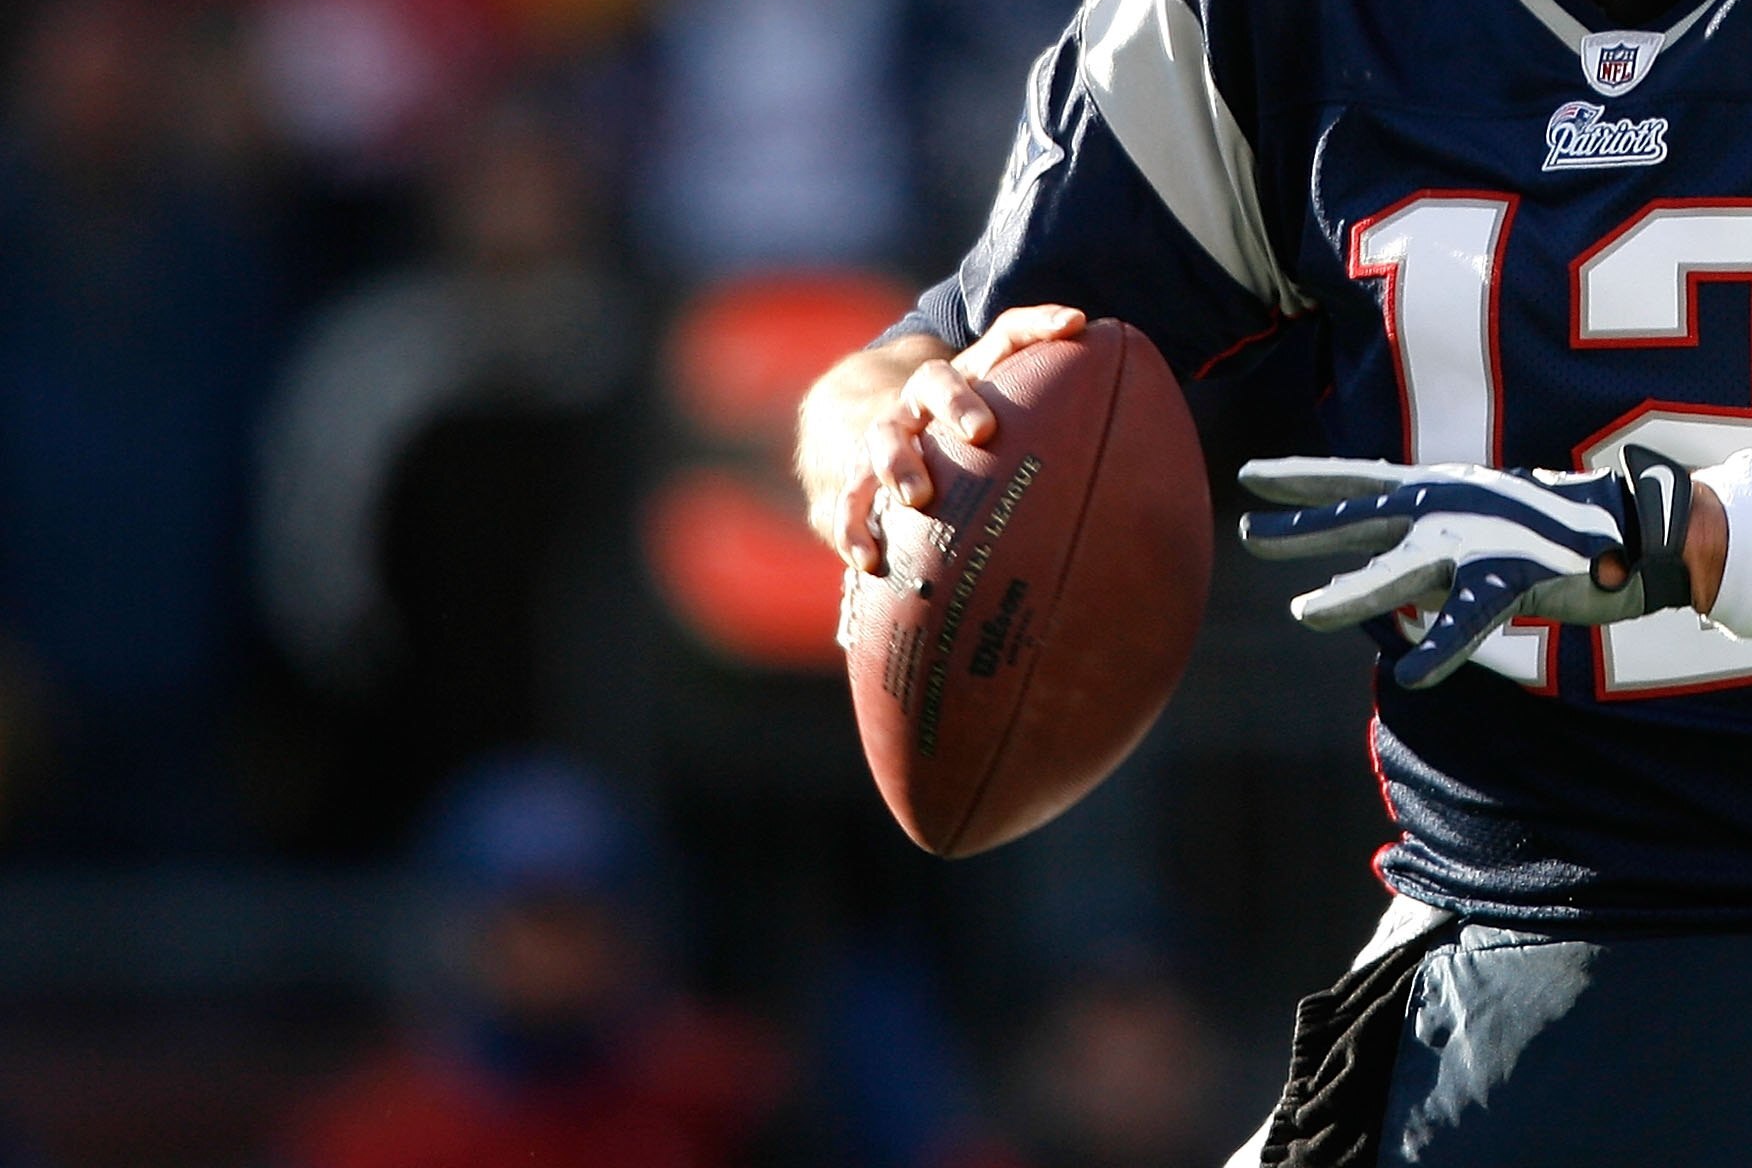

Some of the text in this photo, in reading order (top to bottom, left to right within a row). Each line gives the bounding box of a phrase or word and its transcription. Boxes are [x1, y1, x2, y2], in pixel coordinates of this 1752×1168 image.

[1601, 61, 1632, 82] NFL
[1548, 117, 1667, 166] Patriots
[984, 452, 1043, 539] LEAGUE
